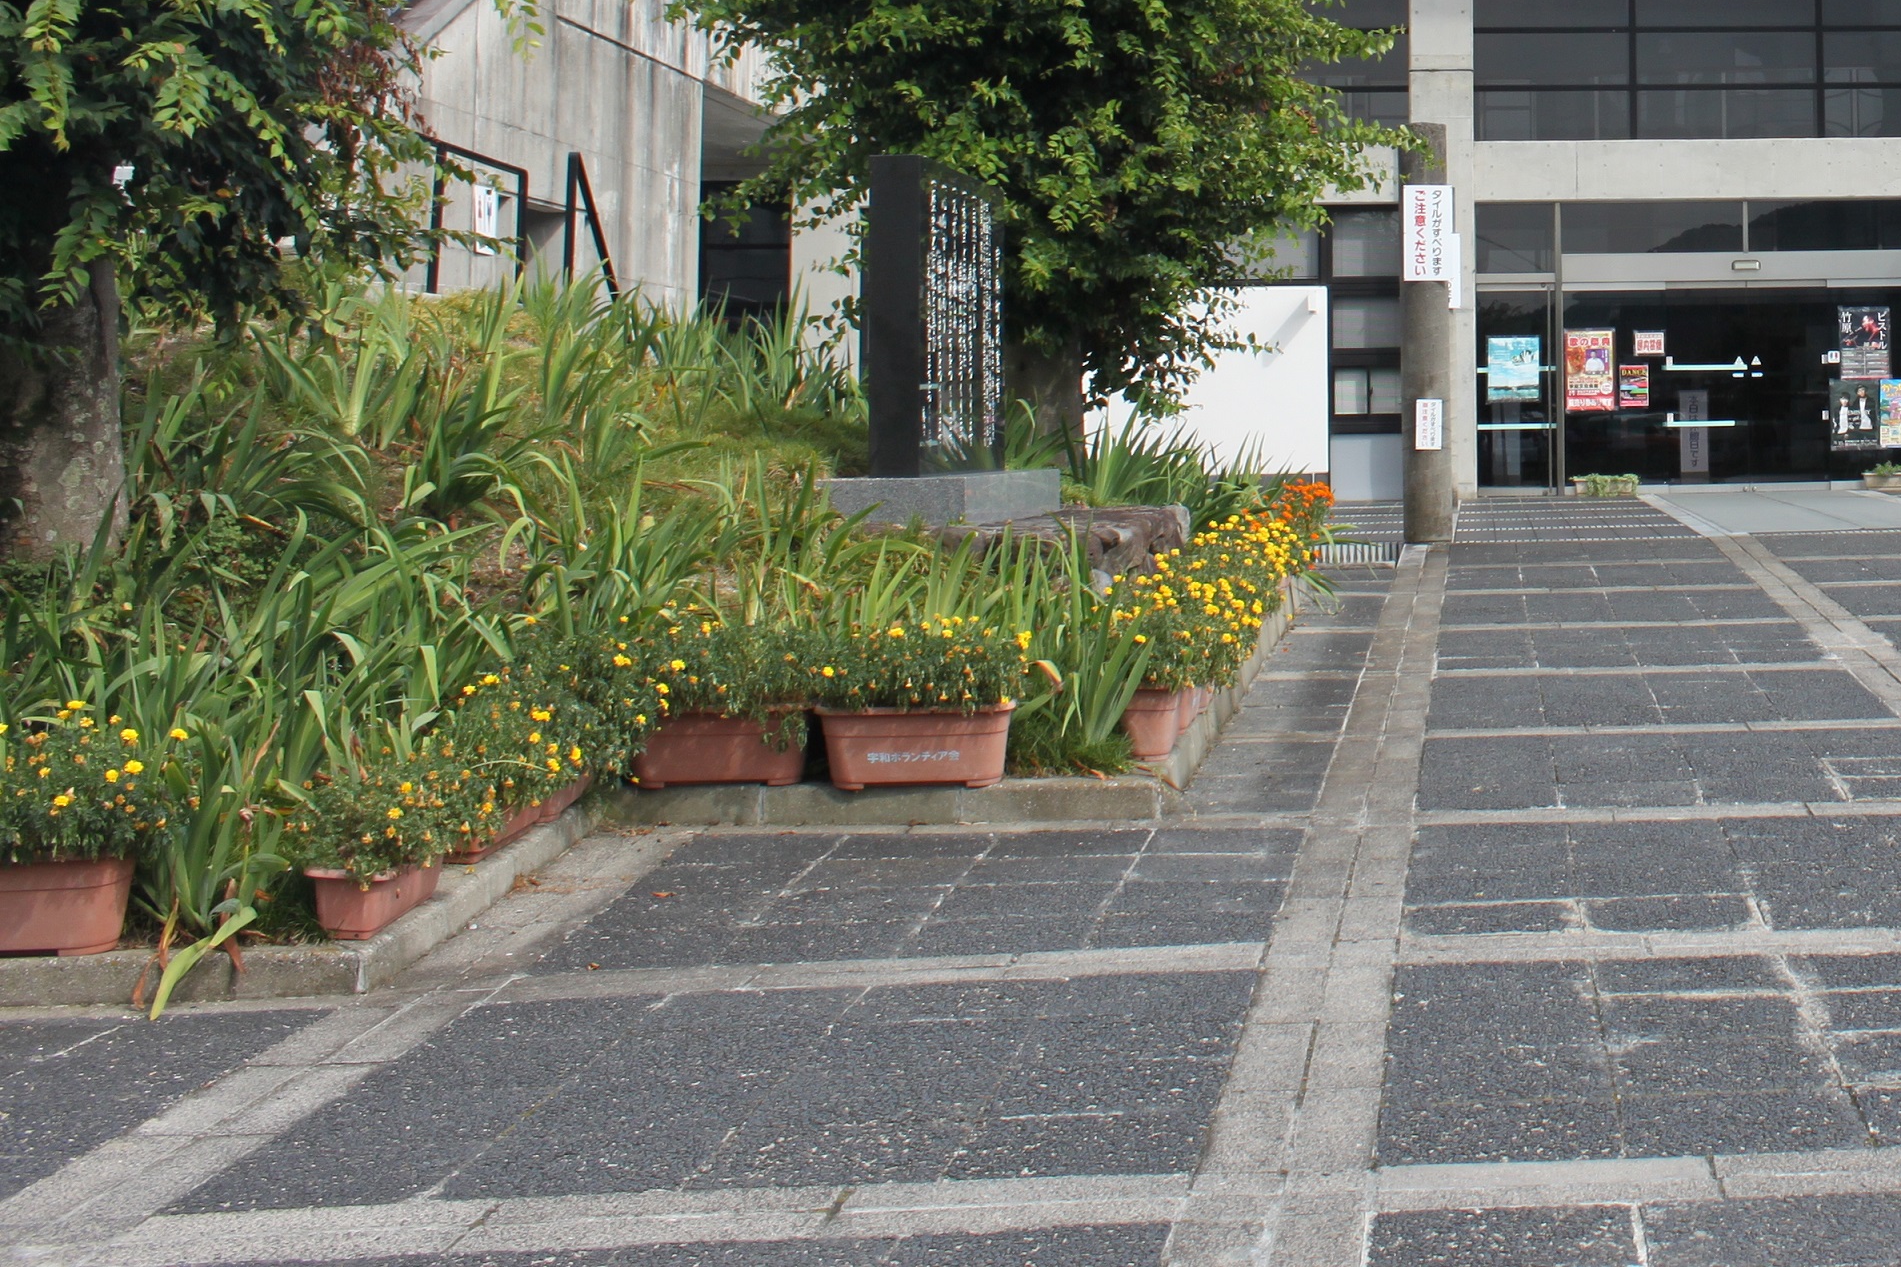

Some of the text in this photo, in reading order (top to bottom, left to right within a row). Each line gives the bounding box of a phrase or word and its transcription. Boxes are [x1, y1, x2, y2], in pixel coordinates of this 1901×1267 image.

[1414, 189, 1427, 276] ご注意ください
[1431, 189, 1442, 276] タイルがすべります
[1841, 311, 1853, 334] 竹原
[1877, 311, 1888, 350] ピストル
